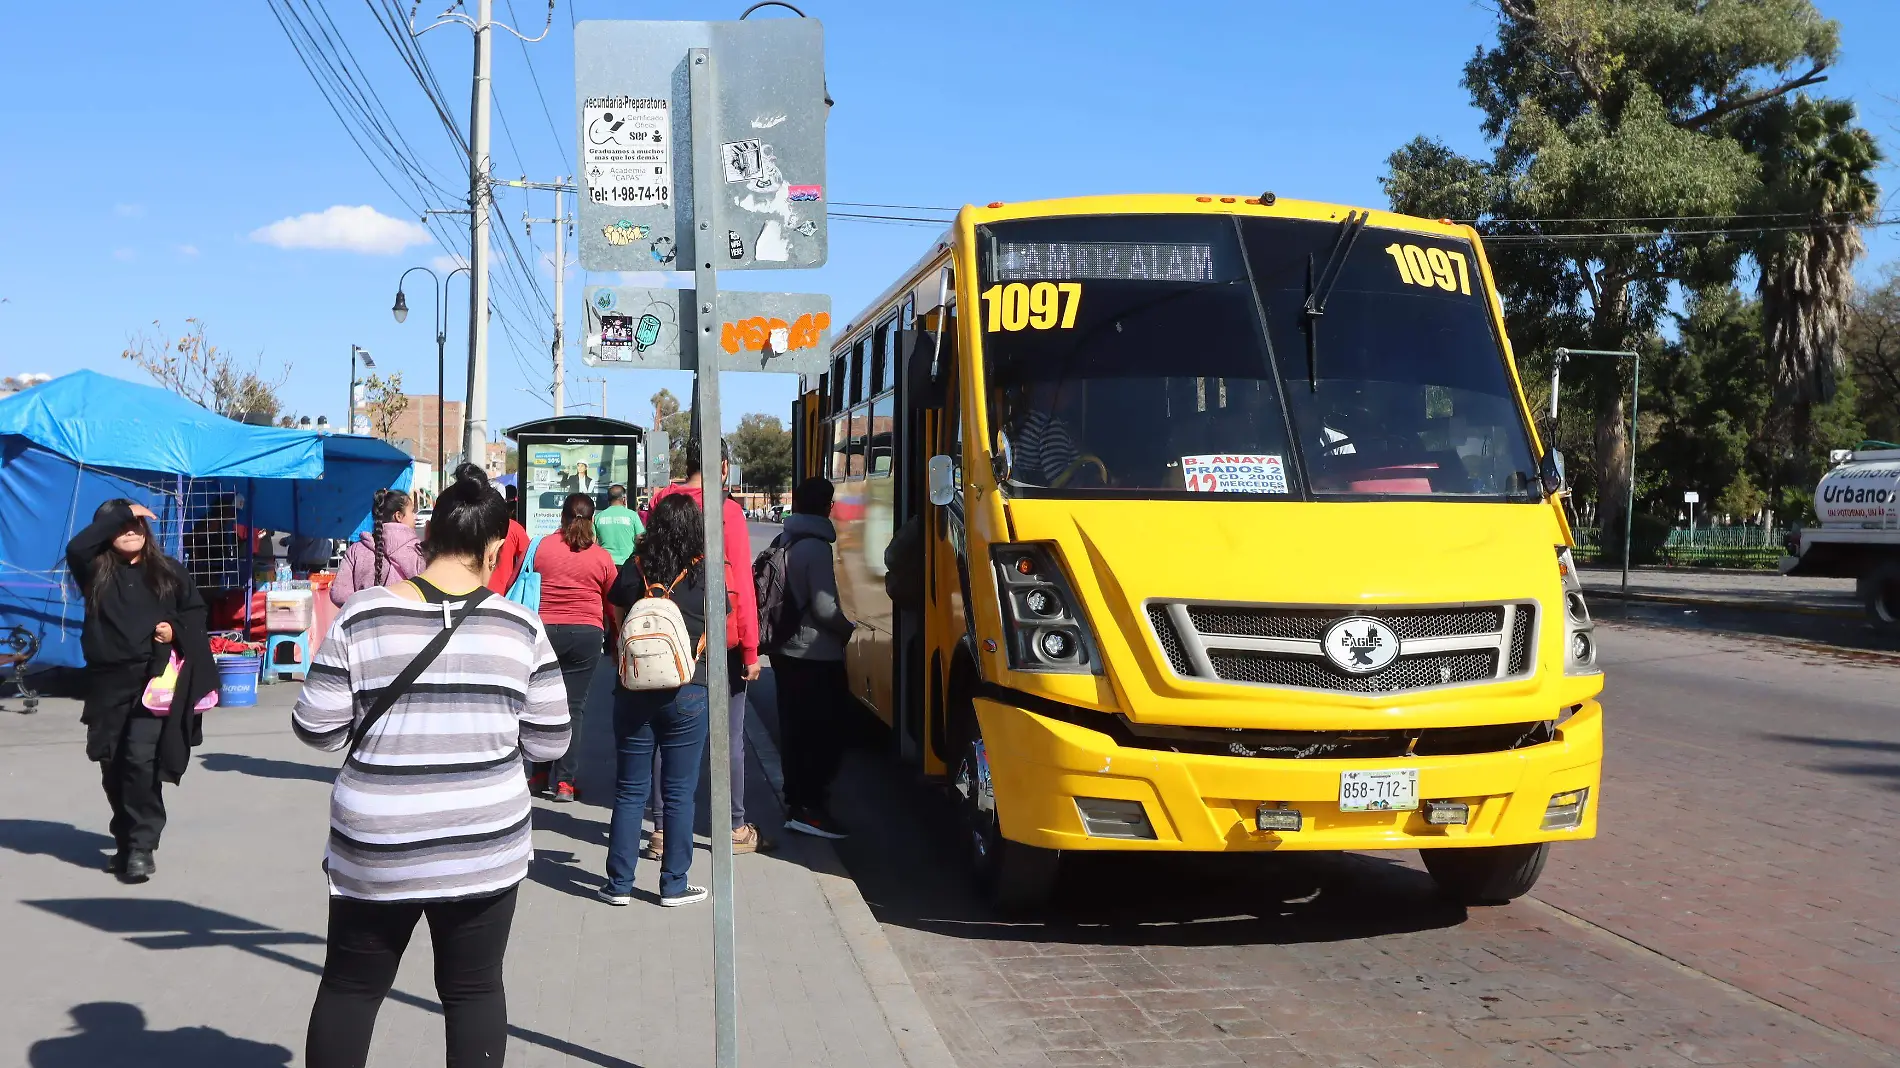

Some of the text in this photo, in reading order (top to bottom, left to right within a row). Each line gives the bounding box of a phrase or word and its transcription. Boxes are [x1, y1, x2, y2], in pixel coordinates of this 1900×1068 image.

[589, 186, 669, 201] Tel: 1-98-74-18
[1384, 243, 1472, 297] 1097
[981, 281, 1082, 333] 1097
[1184, 456, 1280, 466] B. ANAYA
[1186, 465, 1281, 474] PRADOS 2
[1188, 473, 1217, 492] 12
[1220, 480, 1285, 489] MERCEDES
[1823, 485, 1896, 503] Urbanos
[1341, 637, 1383, 647] EAGLE
[1344, 779, 1417, 798] 858-712-T
